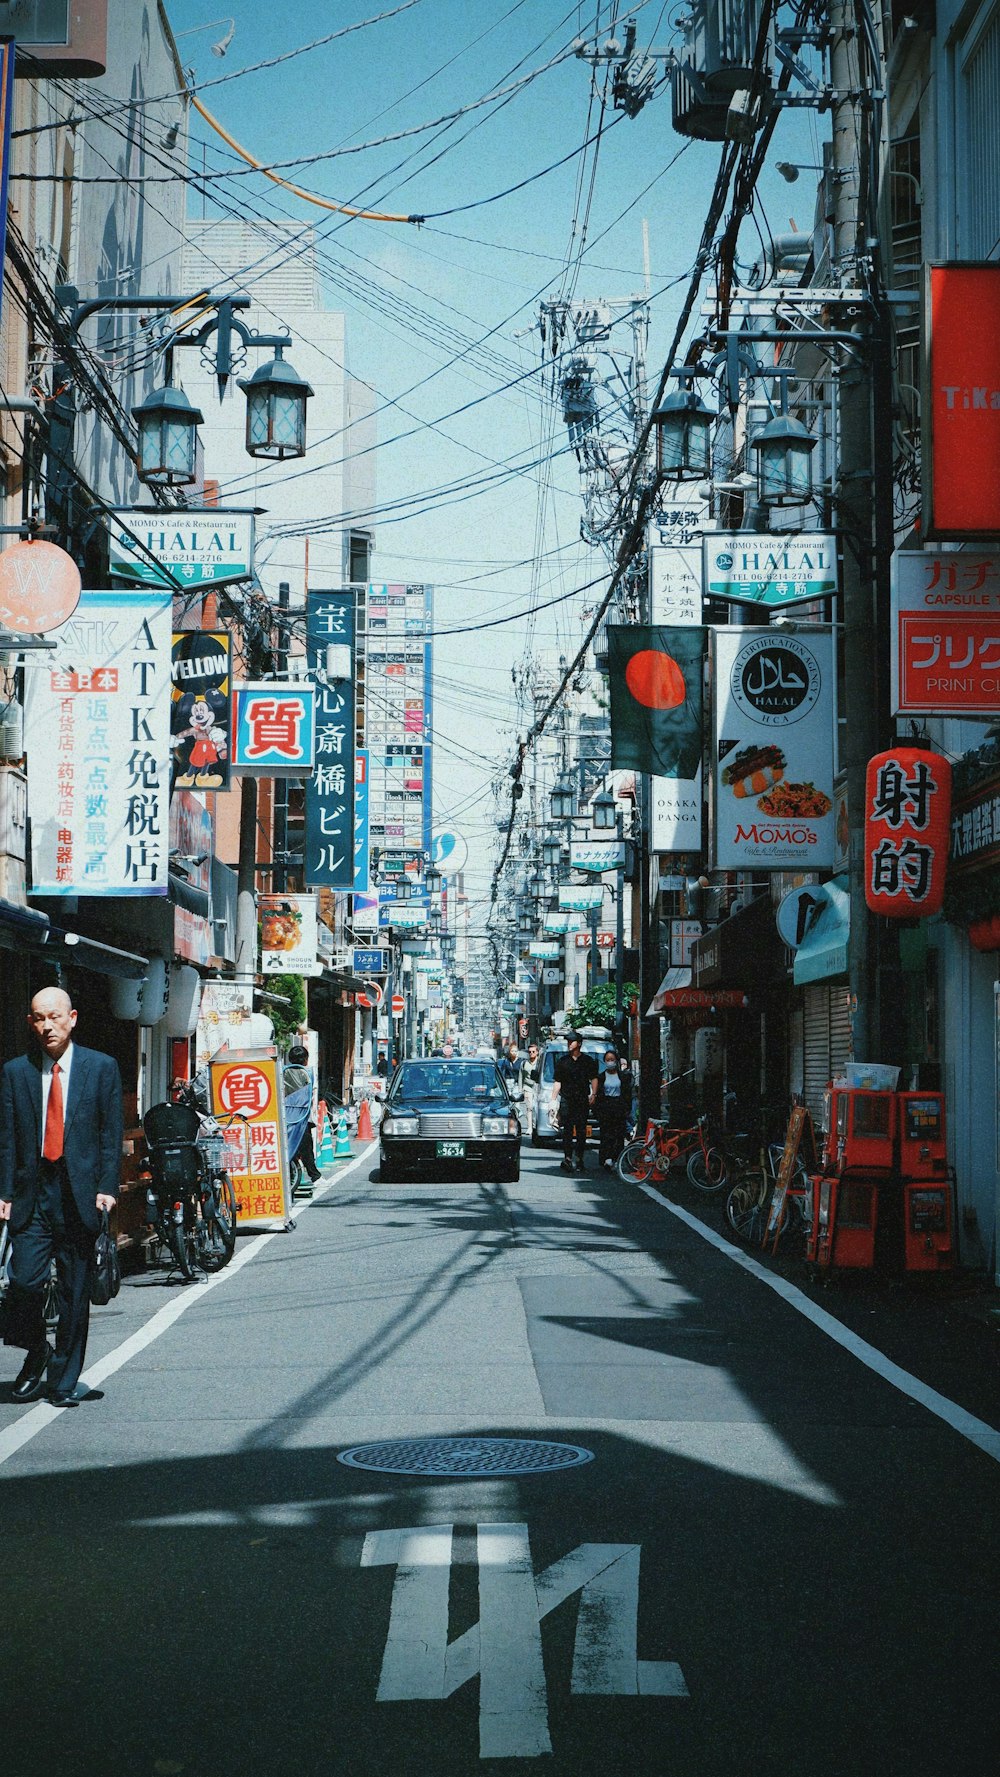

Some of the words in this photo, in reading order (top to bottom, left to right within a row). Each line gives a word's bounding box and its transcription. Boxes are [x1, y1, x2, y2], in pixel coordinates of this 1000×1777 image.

[129, 519, 165, 527] MOMO'S
[167, 519, 185, 528] Cafe
[192, 520, 237, 529] Restaurant
[147, 532, 242, 551] HALAL
[157, 554, 222, 562] 06-6214-2716
[742, 553, 831, 570] HALAL
[142, 564, 215, 579] 三ツ寺筋
[733, 573, 748, 581] TEL
[751, 573, 813, 581] 06-6214-2716
[661, 574, 675, 617] ホルモン
[679, 573, 695, 618] 和牛焼肉
[739, 582, 807, 596] 三ツ寺筋
[924, 594, 989, 605] CAPSULE
[171, 653, 228, 681] YELLOW
[733, 663, 743, 692] HALAL
[741, 639, 805, 660] CERTIFICATION
[805, 656, 819, 694] AGENCY
[53, 670, 117, 691] 全日本
[927, 678, 975, 691] PRINT
[755, 697, 797, 705] HALAL
[247, 700, 303, 759] 質
[314, 604, 346, 872] 宝心斎橋ビル
[872, 760, 937, 901] 射的
[225, 1074, 265, 1116] 質
[251, 1125, 277, 1172] 販売
[249, 1177, 280, 1191] FREE
[236, 1194, 282, 1217] 料査定
